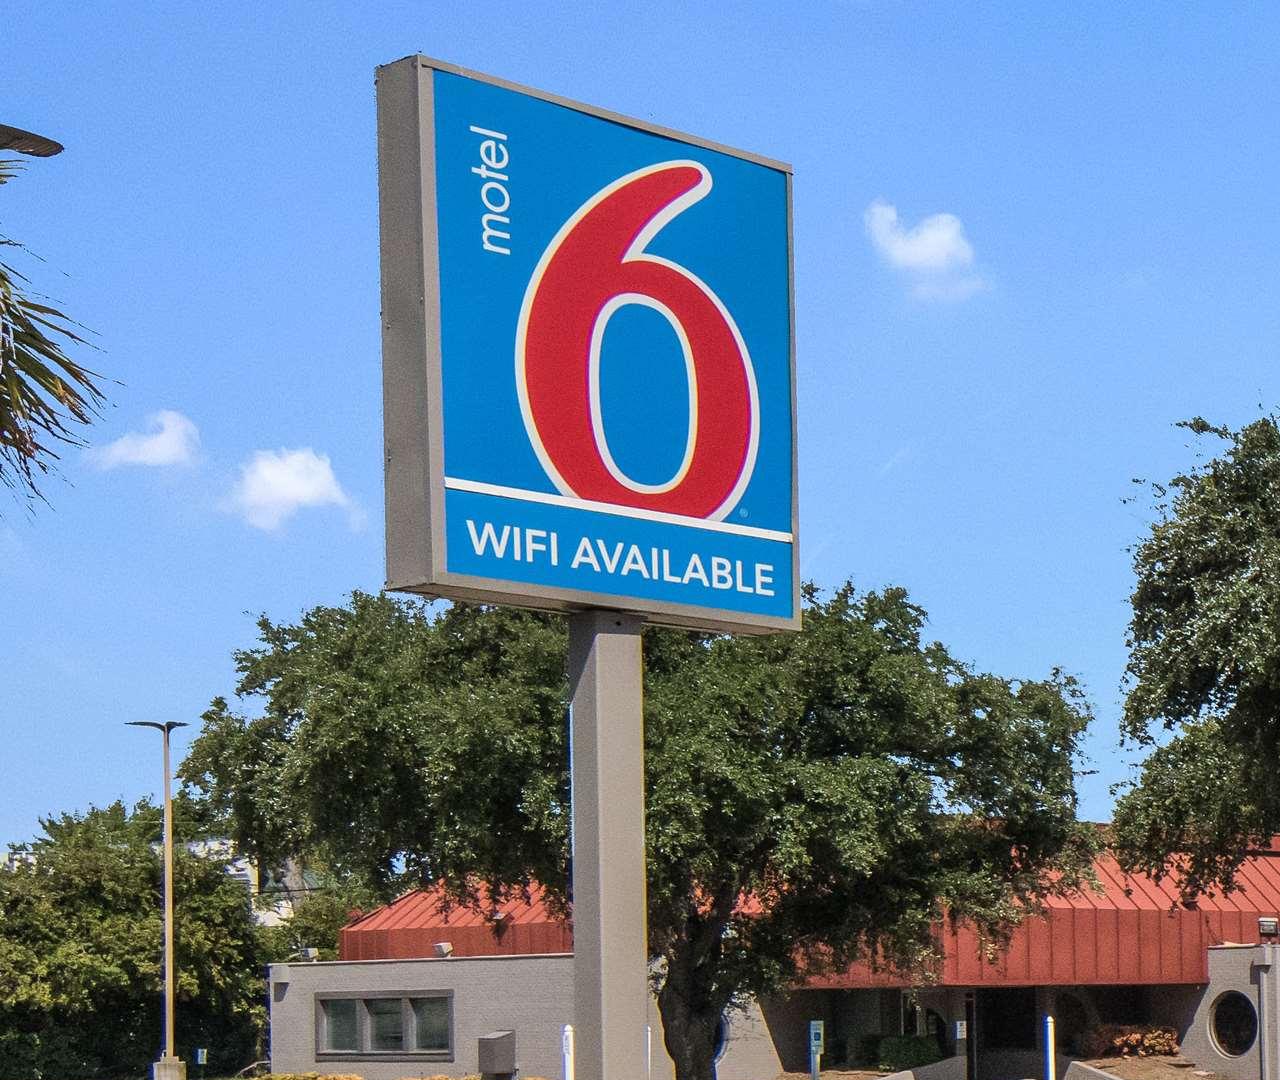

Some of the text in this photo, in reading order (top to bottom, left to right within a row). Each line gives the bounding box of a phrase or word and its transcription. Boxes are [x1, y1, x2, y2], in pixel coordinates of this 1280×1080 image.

[469, 125, 511, 255] motel
[514, 159, 761, 522] 6
[466, 519, 775, 597] WIFI AVAILABLE
